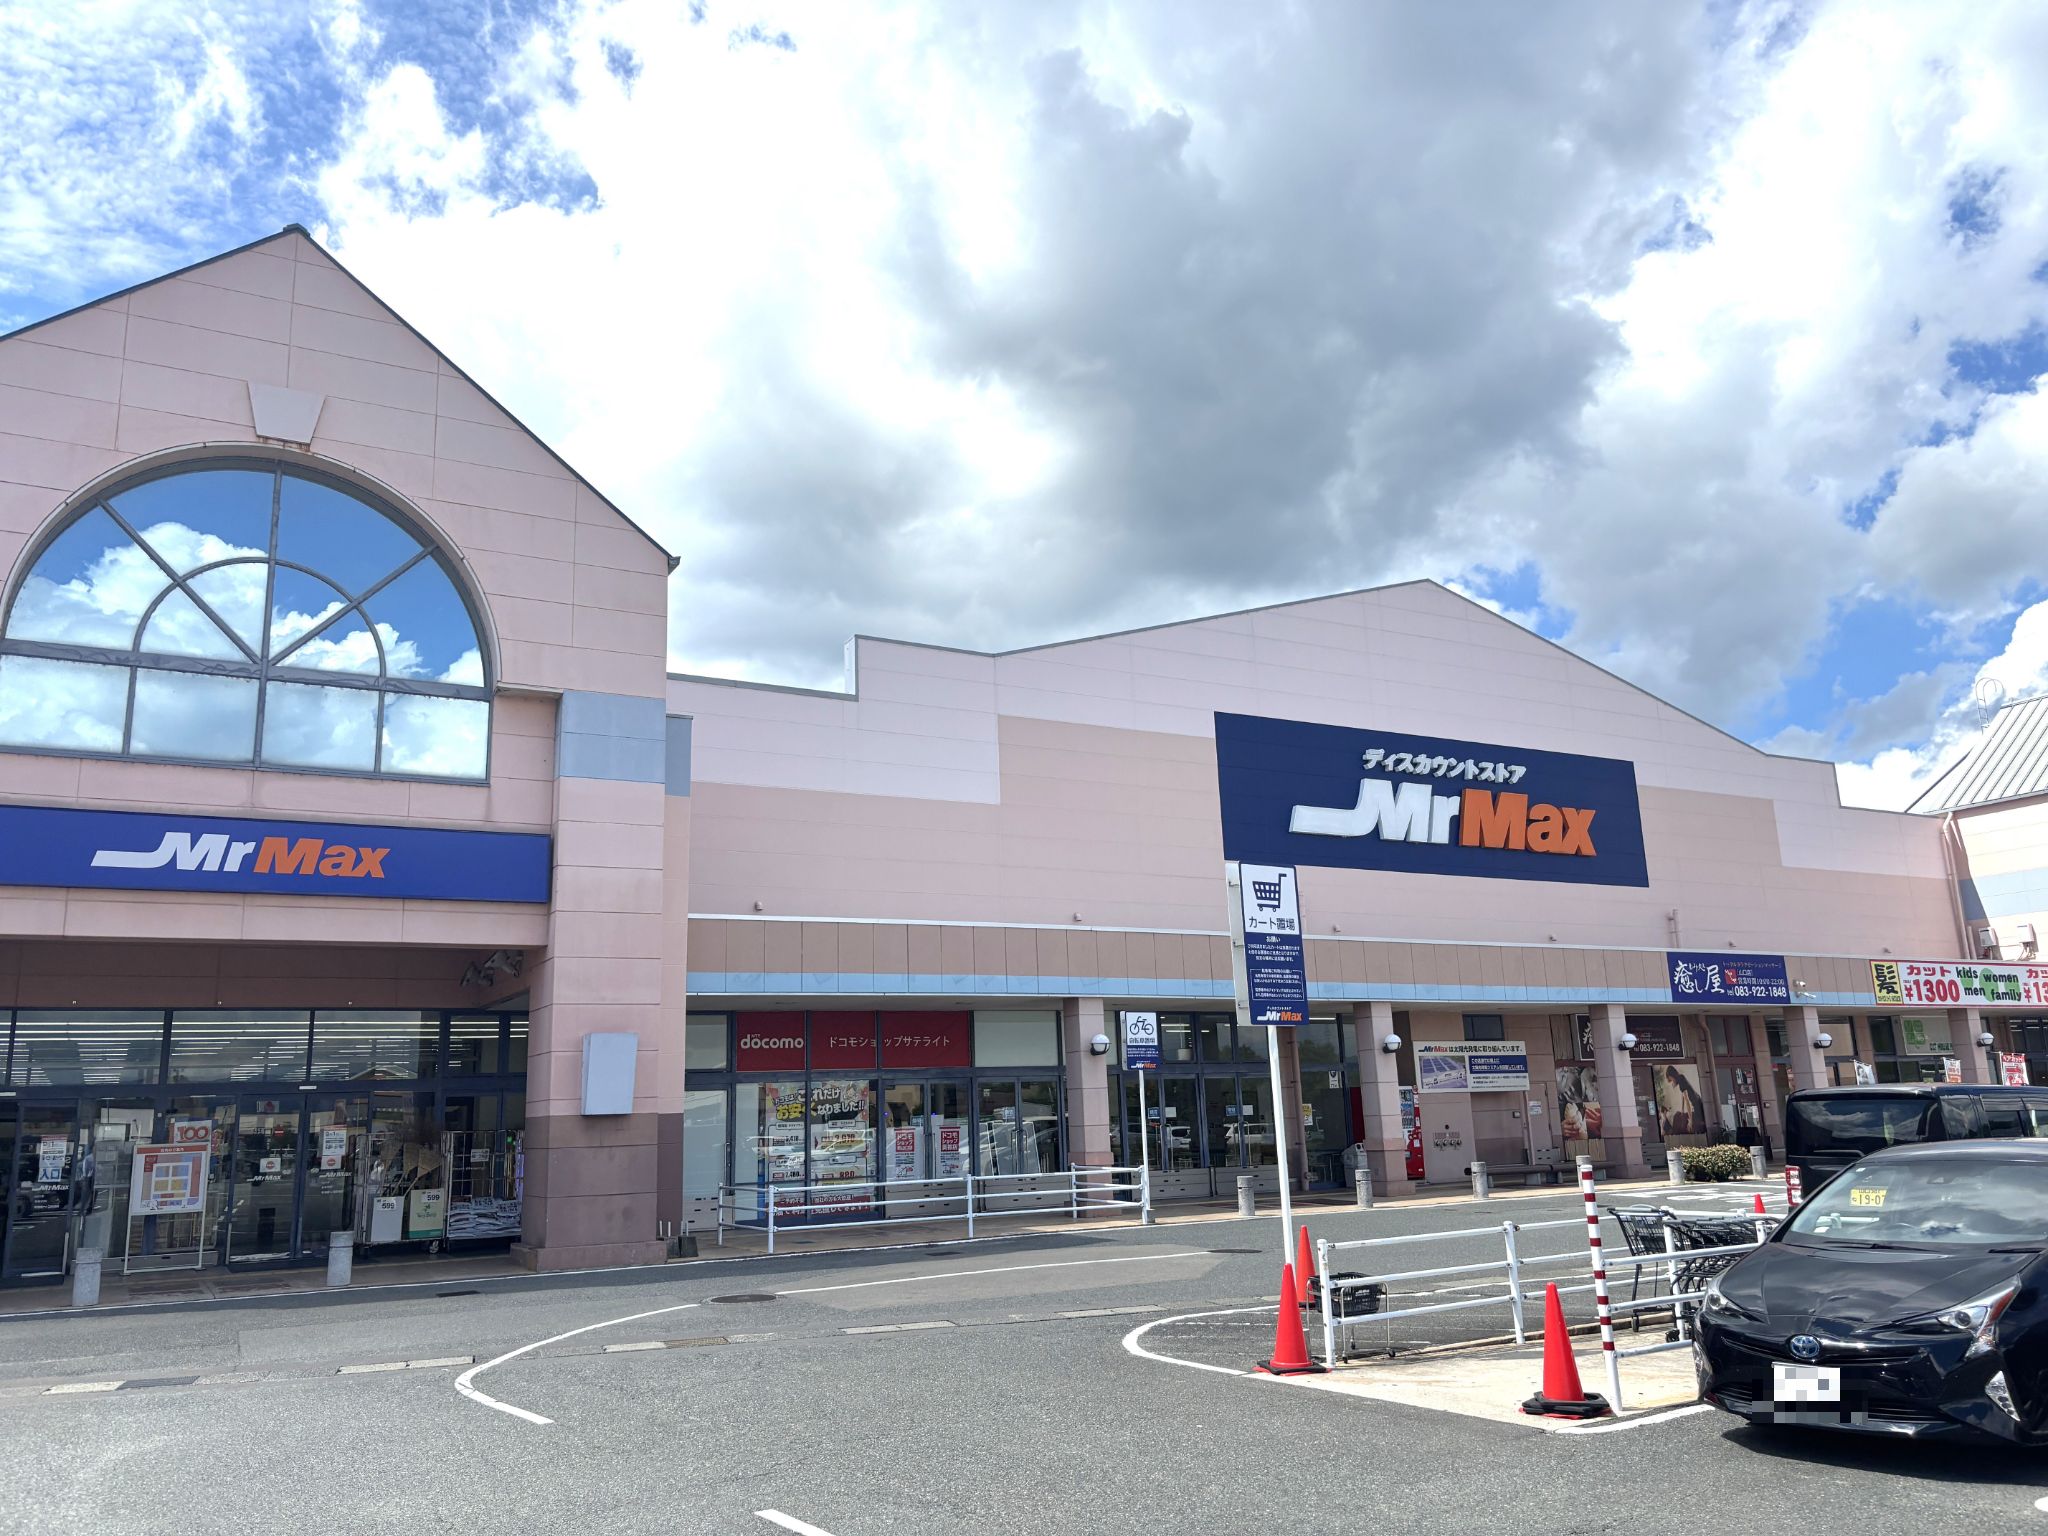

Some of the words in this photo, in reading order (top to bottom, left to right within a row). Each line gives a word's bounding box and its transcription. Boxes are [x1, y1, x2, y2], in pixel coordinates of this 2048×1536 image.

[1363, 749, 1526, 784] ディスカウントストア
[1289, 778, 1597, 857] MrMax
[90, 831, 391, 878] MrMax
[1249, 916, 1295, 930] カート置場
[1907, 965, 1951, 977] カット
[1956, 967, 1978, 979] kids
[1983, 972, 2019, 983] women
[1735, 986, 1787, 997] 083-922-1848
[1904, 978, 1961, 1003] ¥1300
[1964, 986, 1985, 996] men
[1990, 988, 2022, 1002] family
[1257, 1011, 1302, 1021] MrMax
[740, 1034, 804, 1049] docomo
[829, 1035, 950, 1048] ドコモショップサテライト
[1640, 1043, 1680, 1052] 083-922-1848
[40, 1169, 61, 1180] 入口
